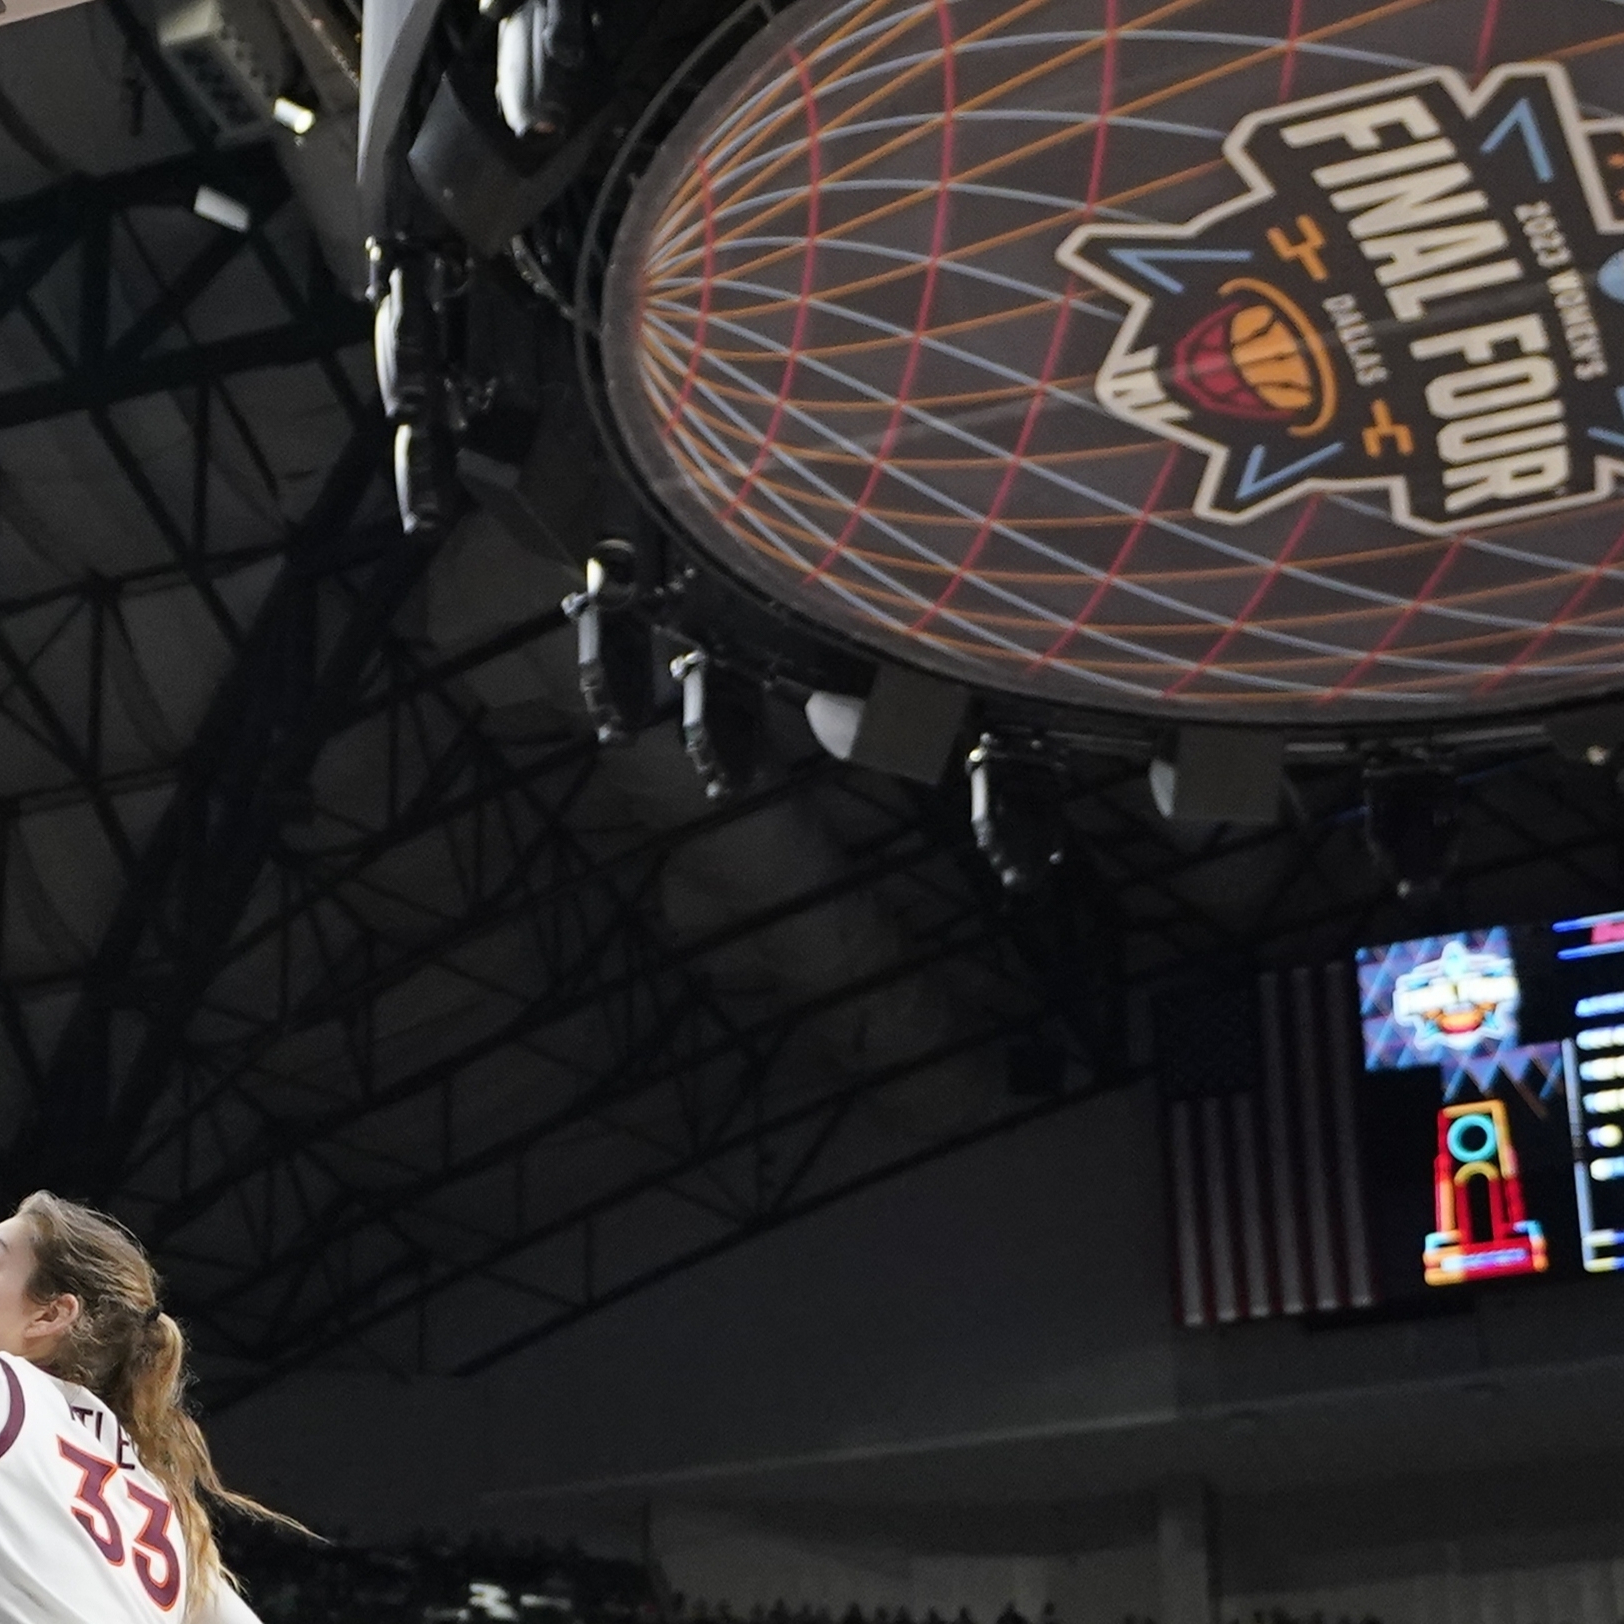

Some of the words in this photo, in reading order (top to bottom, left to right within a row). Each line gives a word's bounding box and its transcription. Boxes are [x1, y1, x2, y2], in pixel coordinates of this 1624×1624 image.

[1281, 95, 1523, 322] FINAL
[1409, 313, 1572, 513] FOUR
[1514, 200, 1573, 269] 2023
[55, 1433, 181, 1612] 33
